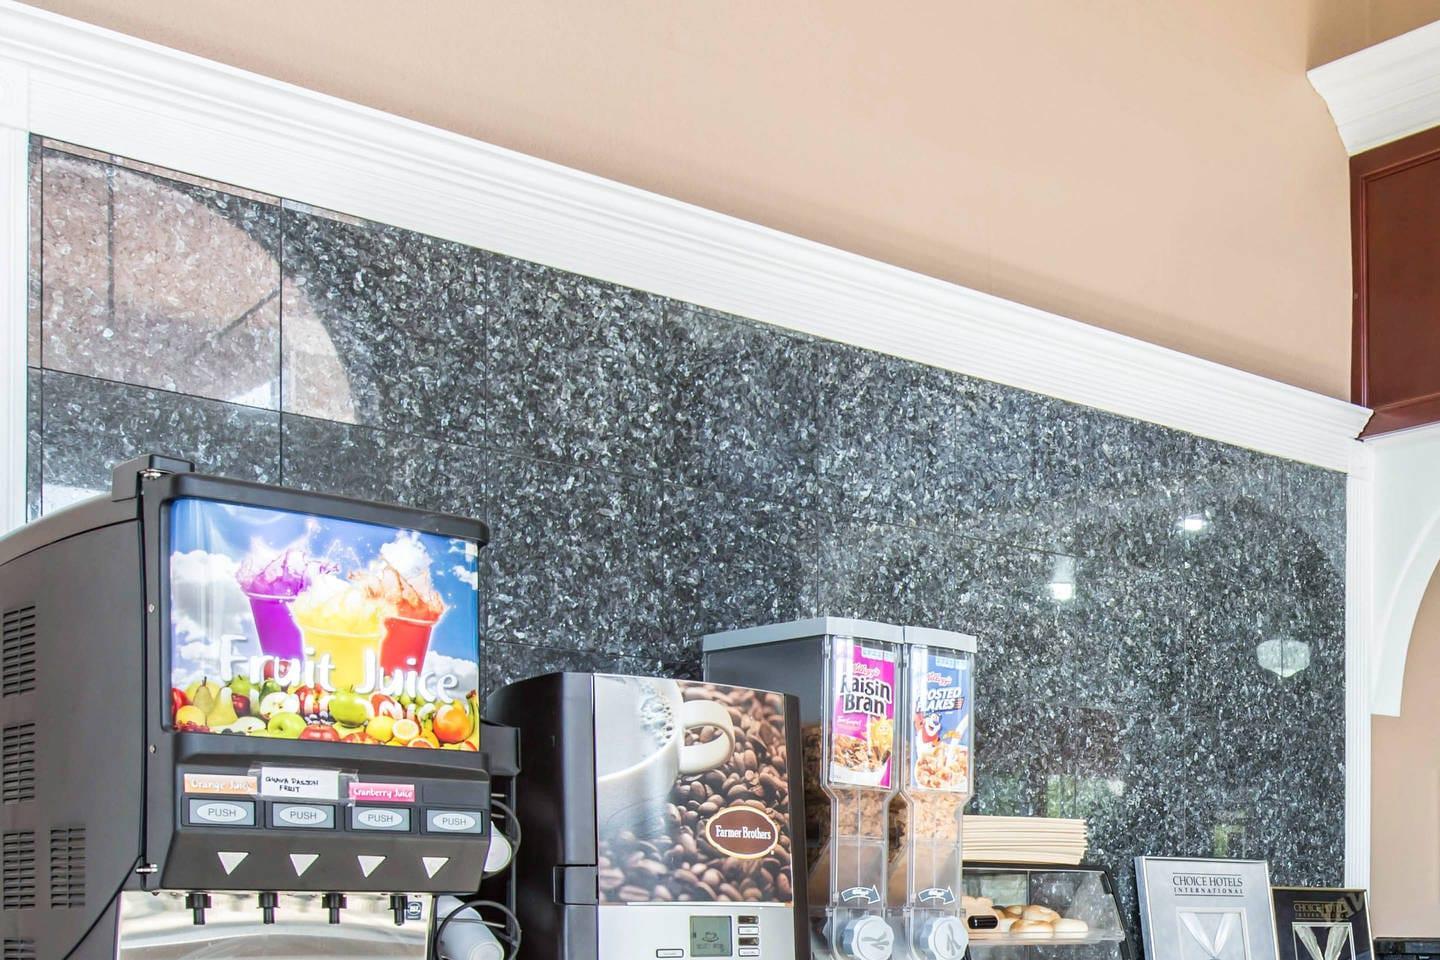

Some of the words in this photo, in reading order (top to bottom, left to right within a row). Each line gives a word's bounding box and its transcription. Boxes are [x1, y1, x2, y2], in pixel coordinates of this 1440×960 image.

[219, 633, 336, 692] Fruit
[355, 648, 459, 703] Juice
[845, 693, 885, 714] Bran
[353, 787, 392, 800] Cranberry
[394, 788, 414, 798] Juice
[207, 808, 237, 819] PUSH
[289, 810, 317, 821] PUSH
[367, 813, 394, 824] PUSH
[441, 816, 467, 827] PUSH
[715, 825, 742, 838] Farmer
[742, 826, 772, 840] Brothers
[1173, 875, 1207, 886] CHOICE
[1209, 877, 1243, 887] HOTELS
